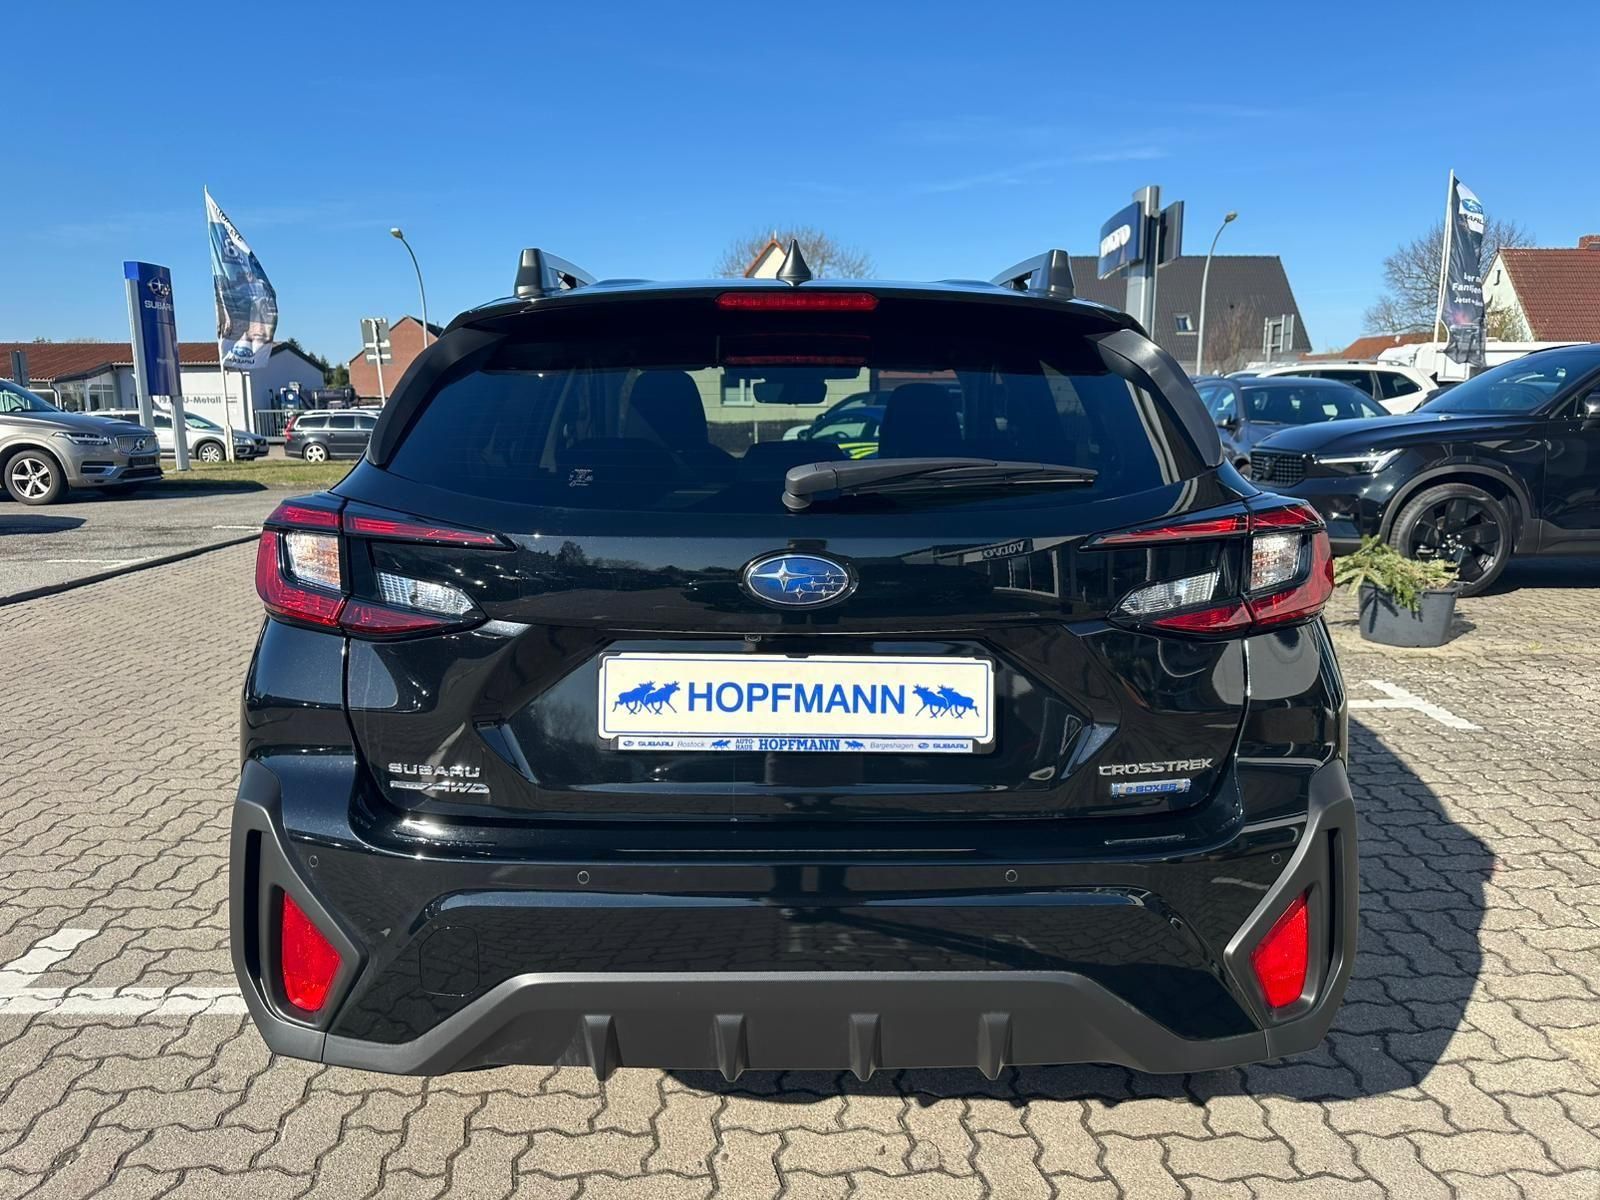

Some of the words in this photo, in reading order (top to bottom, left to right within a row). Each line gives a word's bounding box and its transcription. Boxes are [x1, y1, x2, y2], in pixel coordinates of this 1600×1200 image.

[688, 682, 905, 714] HOPFMANN
[677, 740, 705, 748] Rostock
[759, 738, 840, 750] HOPFMANN
[870, 742, 914, 750] Bargeshagen
[388, 763, 480, 777] SUBARU
[1099, 759, 1213, 776] CROSSTREK
[426, 780, 490, 794] AWD
